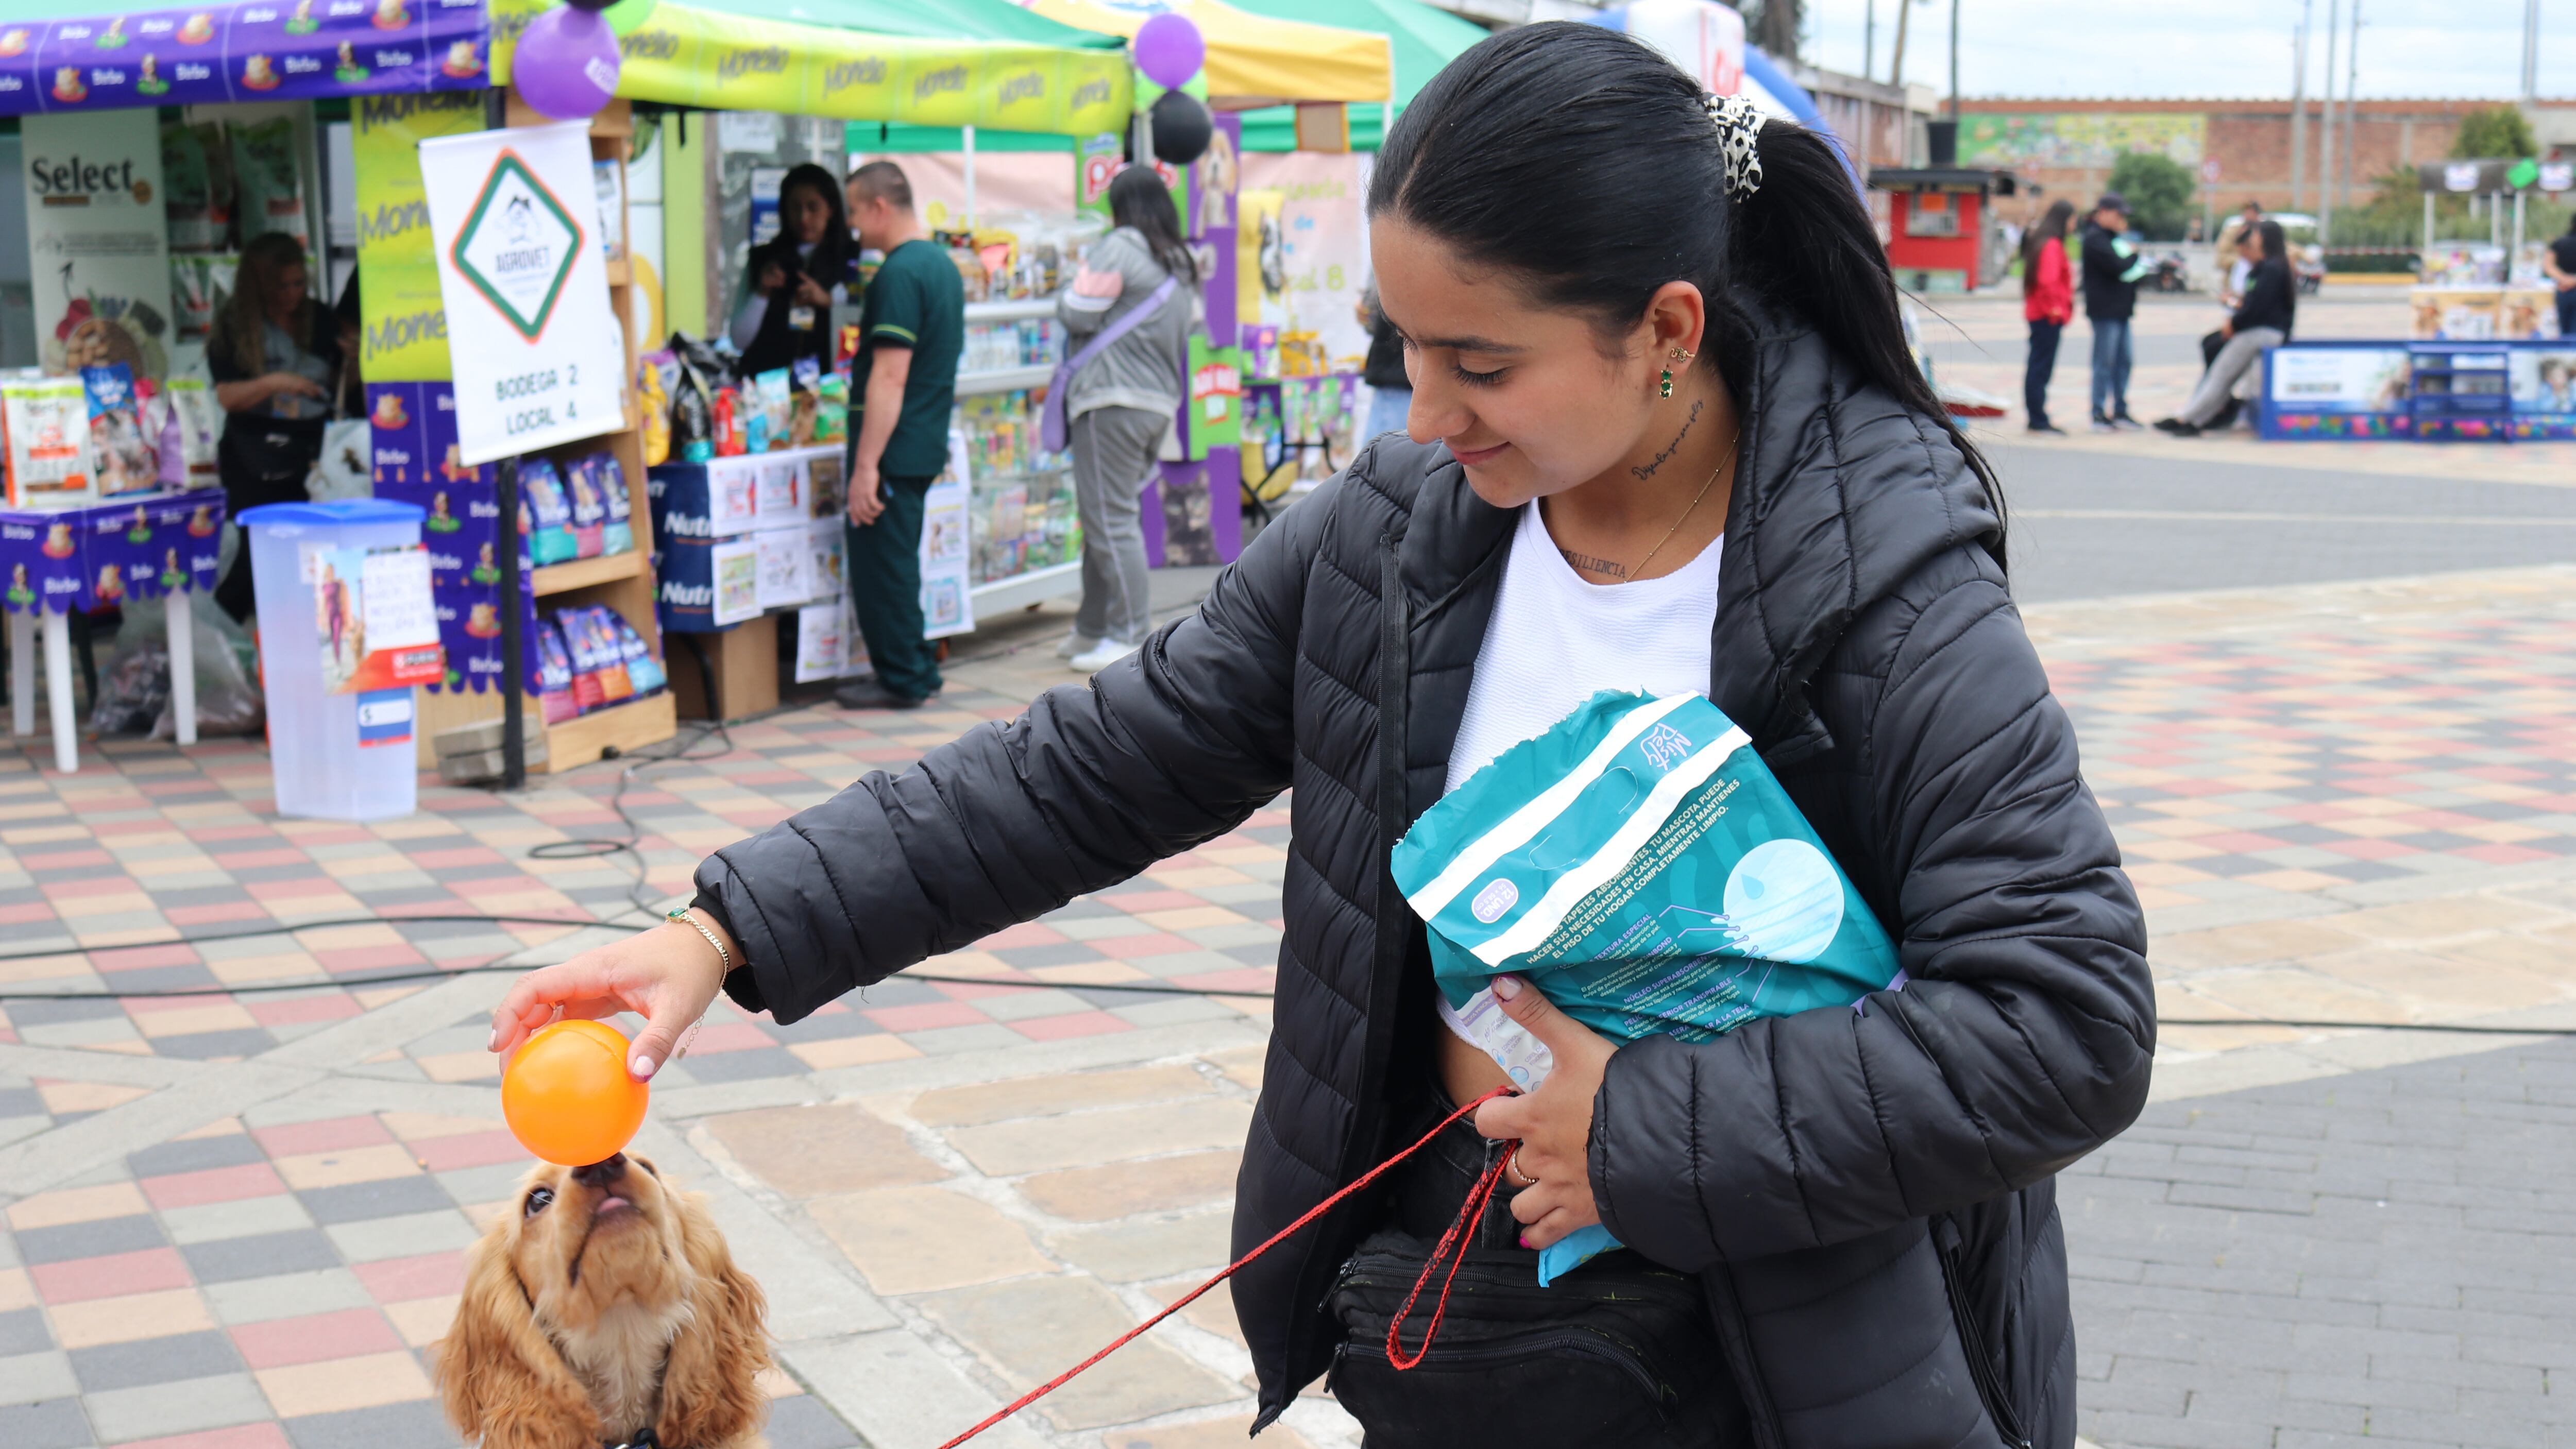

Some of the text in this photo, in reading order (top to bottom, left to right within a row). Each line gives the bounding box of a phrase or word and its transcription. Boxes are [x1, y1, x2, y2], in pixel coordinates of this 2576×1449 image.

[32, 157, 133, 194] Select
[496, 246, 550, 272] AGROVET
[366, 310, 448, 361] Mone
[496, 364, 578, 401] BODEGA 2
[506, 401, 577, 435] LOCAL 4
[661, 581, 713, 606] Nutr
[1563, 896, 1595, 924] TAPETES
[1595, 846, 1651, 896] ABSORBENTES,
[1650, 836, 1662, 847] TU
[1662, 803, 1700, 837] MASCOTA
[1698, 779, 1725, 804] PUEDE
[1527, 943, 1554, 965] HACER
[1553, 931, 1569, 946] SUS
[1569, 887, 1621, 932] NECESIDADES
[1621, 875, 1634, 888] EN
[1633, 855, 1658, 877] CASA,
[1657, 821, 1696, 855] MIENTRAS
[1695, 781, 1740, 820] MANTIENES
[1552, 948, 1563, 959] EL
[1563, 933, 1582, 951] PISO
[1581, 924, 1594, 936] DE
[1592, 914, 1605, 926] TU
[1604, 889, 1634, 915] HOGAR
[1633, 831, 1701, 890] COMPLETAMENTE
[1699, 805, 1729, 831] LIMPIO.
[1475, 902, 1484, 911] cm
[1480, 888, 1514, 917] 12 UND.
[1595, 914, 1652, 960] TEXTURA ESPECIAL
[1628, 925, 1651, 943] absorción
[1630, 942, 1641, 952] lejos
[1583, 988, 1596, 999] pulpa
[1604, 976, 1618, 988] pelusa
[1619, 968, 1635, 982] pueden
[1635, 960, 1650, 973] reducir
[1601, 976, 1631, 999] desagradables
[1635, 968, 1648, 979] evitar
[1608, 954, 1641, 981] superabsorbente
[1624, 954, 1708, 1004] NÚCLEO SUPERABSORBEN
[1633, 990, 1659, 1008] absorbente
[1659, 984, 1670, 993] está
[1670, 974, 1689, 987] diseñado
[1690, 968, 1701, 977] para
[1701, 958, 1718, 969] retener
[1653, 991, 1671, 1004] líquidos
[1676, 978, 1698, 992] neutralizar
[1706, 962, 1722, 974] olores.
[1624, 1013, 1643, 1027] PELÍC
[1685, 979, 1730, 1007] TRANSPIRABLE
[1679, 1006, 1697, 1019] permite
[1720, 985, 1736, 996] respire
[1704, 1002, 1716, 1012] calor
[1727, 990, 1740, 1000] fugas
[1721, 1012, 1731, 1021] LA
[1732, 1003, 1748, 1015] TELA
